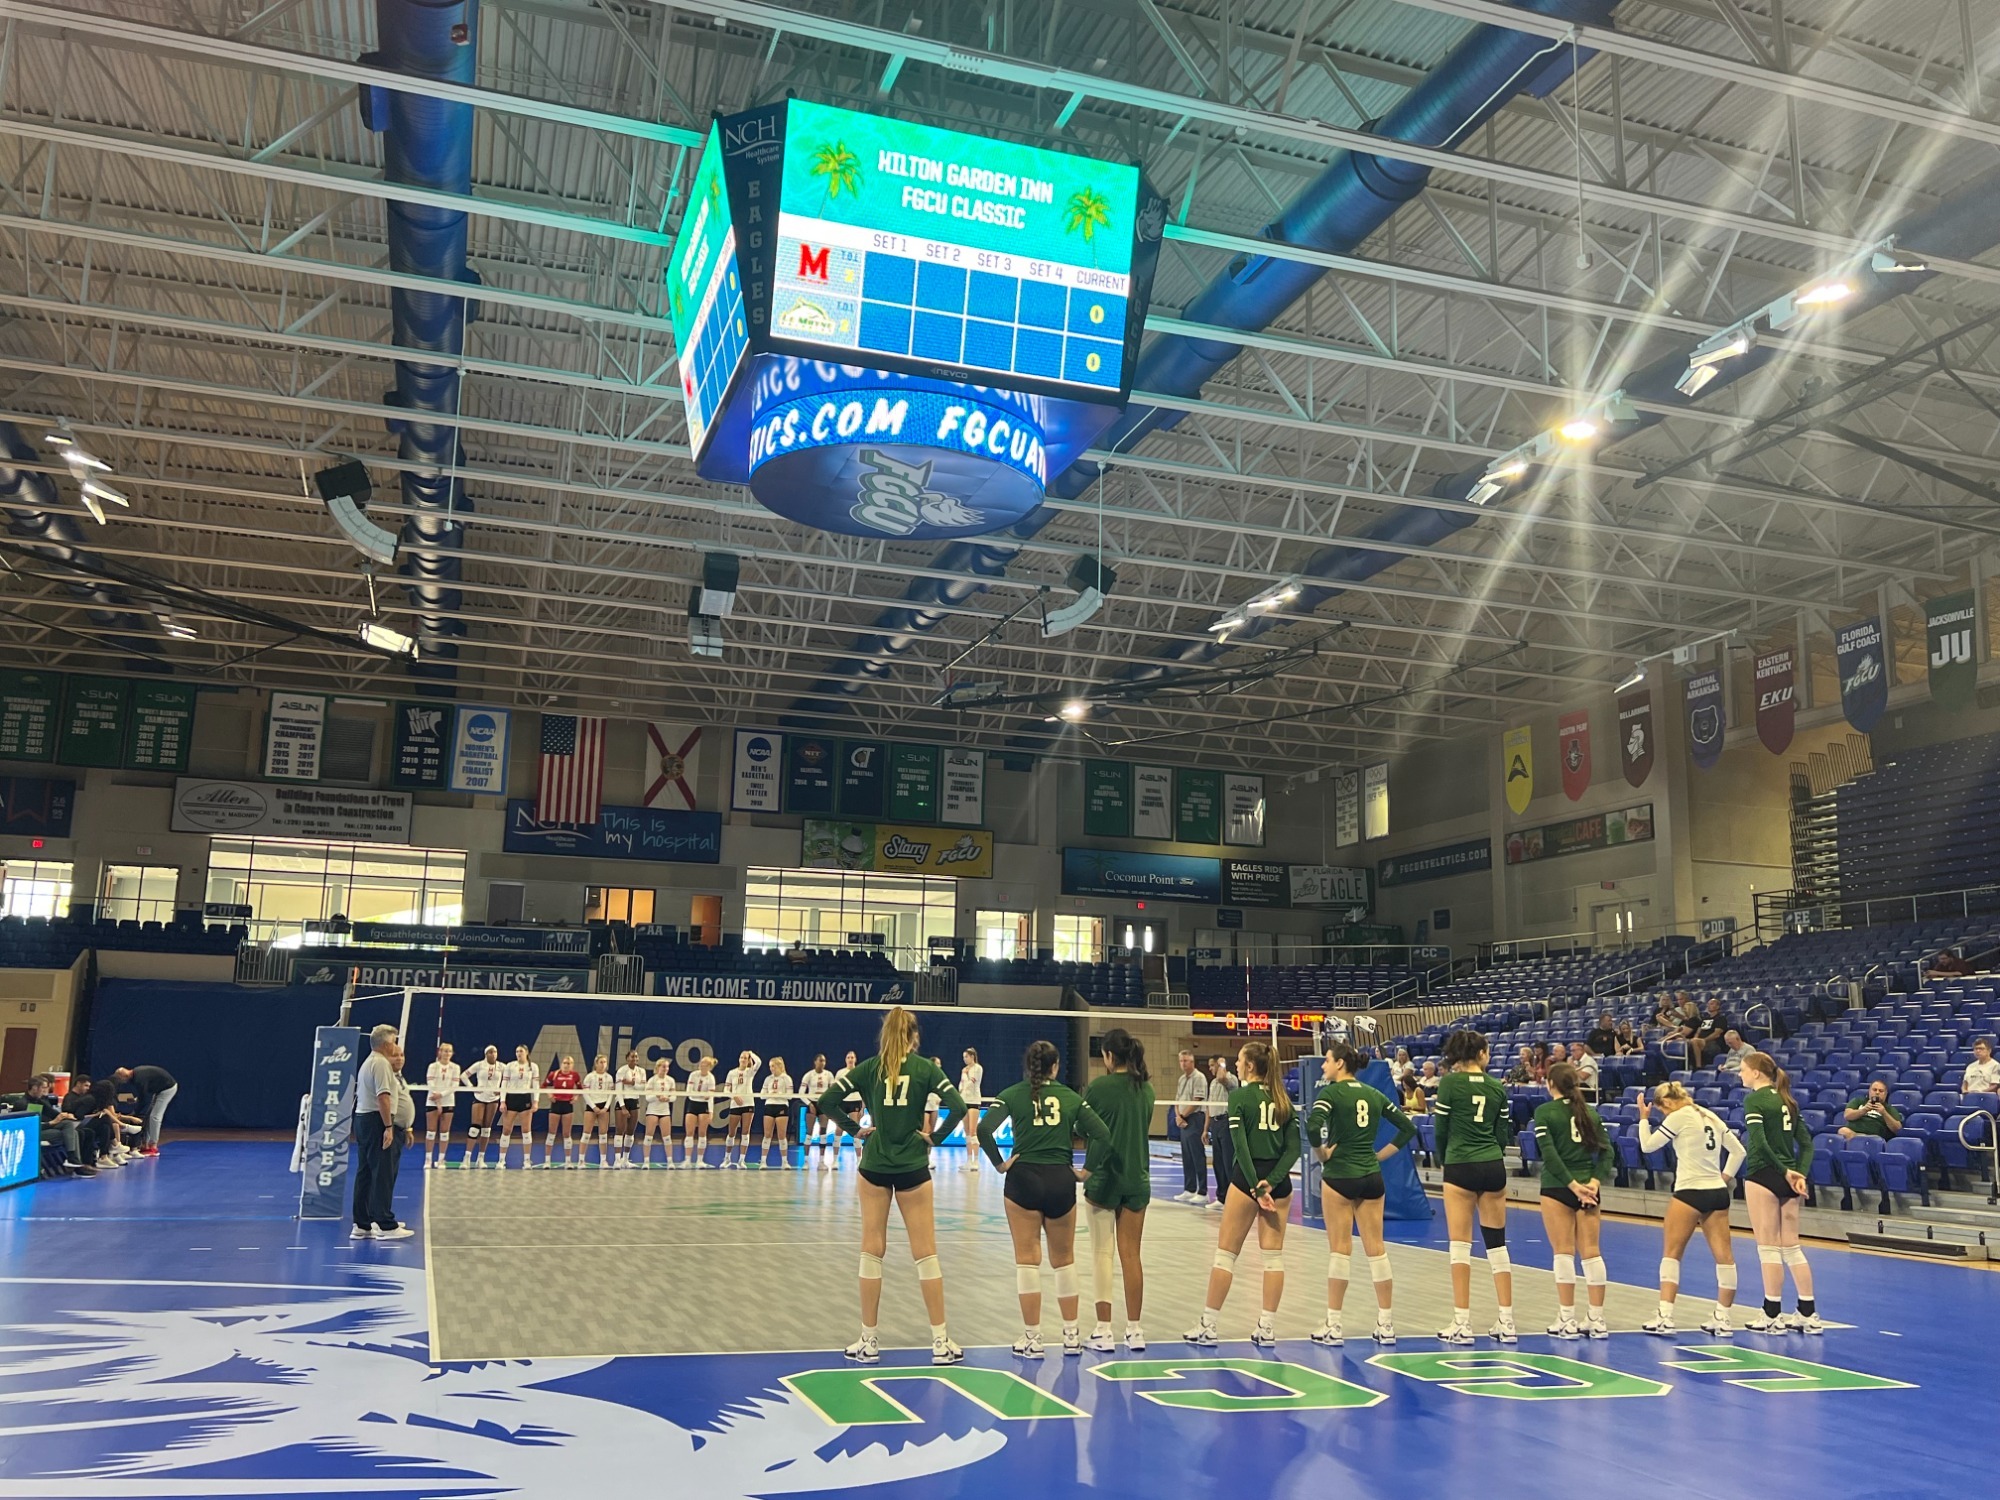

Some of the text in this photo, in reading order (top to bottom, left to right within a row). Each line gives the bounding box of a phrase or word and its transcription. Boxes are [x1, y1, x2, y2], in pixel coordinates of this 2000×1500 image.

[725, 116, 776, 149] NCH
[745, 145, 780, 159] Healthcare
[757, 154, 780, 166] System
[878, 149, 1054, 204] HILTON GARDEN INN
[901, 186, 1026, 230] FGCU CLASSIC
[873, 233, 906, 252] SET 1
[748, 180, 765, 325] EAGLES
[798, 243, 831, 280] M
[927, 244, 961, 262] SET 2
[977, 253, 1012, 271] SET 3
[1030, 262, 1063, 280] SET 4
[1076, 270, 1126, 291] CURRENT
[1089, 304, 1104, 324] 0
[1086, 353, 1101, 373] 0
[1927, 607, 1974, 628] JACKSONVILLE
[1842, 625, 1875, 643] FLORIDA
[1837, 633, 1881, 655] GULF COAST
[1931, 629, 1971, 668] JU
[1758, 652, 1789, 669] EASTERN
[1756, 661, 1792, 680] KENTUCKY
[1689, 675, 1717, 689] CENTRAL
[1687, 683, 1720, 700] ARKANSAS
[1760, 687, 1793, 710] EKU
[279, 702, 319, 712] ASUN
[1620, 705, 1650, 720] BELLARMINE
[470, 727, 495, 735] NCAA
[460, 751, 498, 760] BASKETBALL
[465, 744, 495, 752] WOMEN'S
[749, 748, 772, 756] NCAA
[462, 766, 494, 776] FINALIST
[741, 772, 774, 780] BASKETBALL
[1139, 773, 1168, 783] ASUN
[465, 777, 489, 787] 2007
[1230, 784, 1258, 793] ASUN
[197, 789, 250, 804] Allen
[276, 788, 405, 807] Building Foundations of Trust
[294, 804, 335, 817] Concrete
[337, 806, 394, 820] Construction
[602, 812, 640, 830] This
[651, 815, 666, 831] is
[605, 831, 633, 853] my
[885, 834, 982, 865] Starry FGCU
[1105, 871, 1146, 883] Coconut
[1149, 874, 1174, 885] Point
[1231, 864, 1284, 874] EAGLES RIDE
[1231, 872, 1280, 882] WITH PRIDE
[1321, 878, 1363, 900] EAGLE
[1794, 910, 1810, 924] EE
[646, 925, 664, 937] AA
[1711, 920, 1725, 933] DD
[370, 927, 525, 945] fgcuathletics.com/JoinOurTeam
[1421, 948, 1437, 958] CC
[347, 966, 439, 988] PROTECT
[444, 970, 482, 989] THE
[489, 972, 538, 991] NEST
[665, 975, 750, 999] WELCOME
[756, 979, 776, 999] TO
[781, 981, 872, 1003] #DUNKCITY
[1292, 1015, 1300, 1030] 0
[526, 1024, 714, 1073] Alico
[320, 1053, 352, 1066] FGCU
[884, 1075, 910, 1106] 17
[1033, 1097, 1061, 1126] 13
[1259, 1101, 1280, 1131] 10
[1356, 1099, 1369, 1128] 8
[1472, 1095, 1486, 1122] 7
[1781, 1105, 1792, 1131] 2
[318, 1070, 342, 1187] EAGLES
[1704, 1125, 1716, 1151] 3
